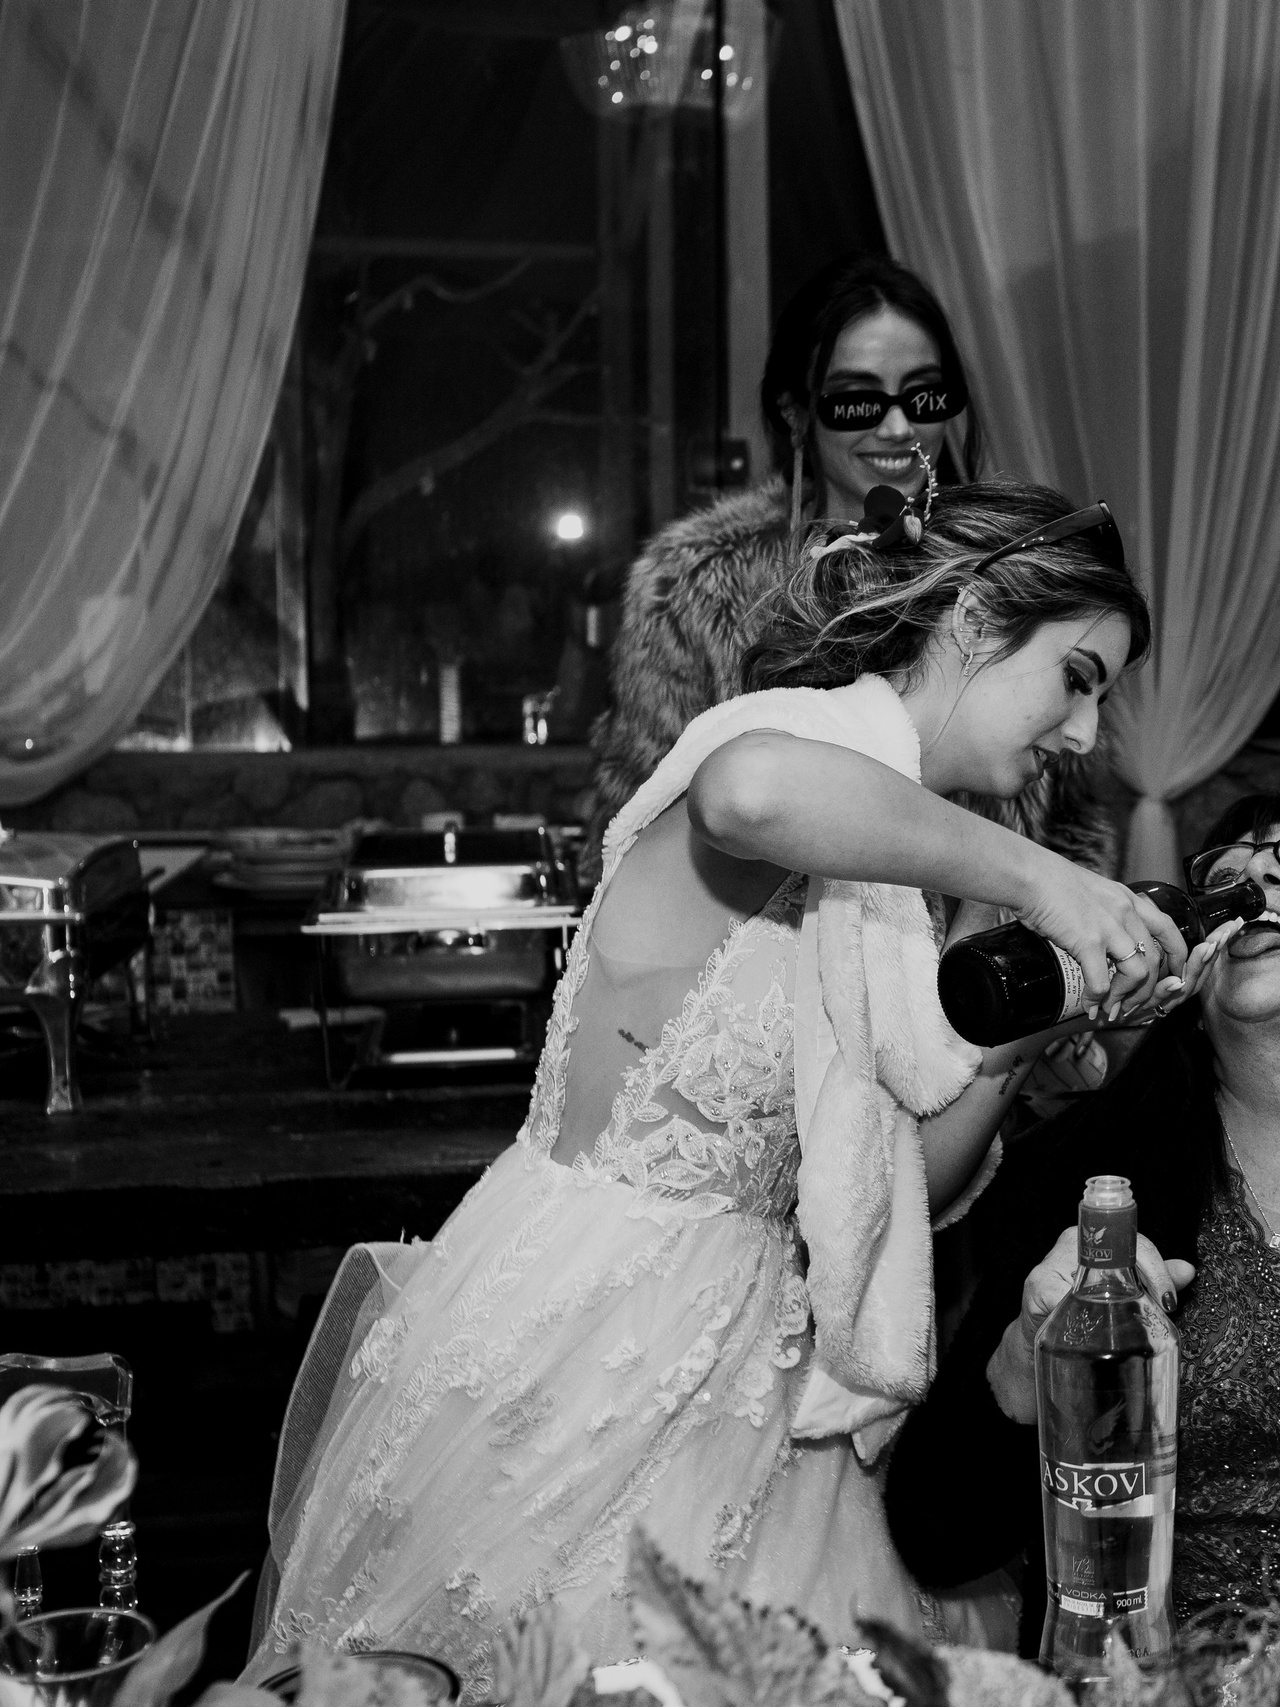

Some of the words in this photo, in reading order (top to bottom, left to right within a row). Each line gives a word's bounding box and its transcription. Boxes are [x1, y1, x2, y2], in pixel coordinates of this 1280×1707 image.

[834, 402, 882, 419] MANDA
[911, 390, 947, 415] Pix
[1081, 1247, 1111, 1259] SKOV
[1043, 1461, 1139, 1496] ASKOV
[1065, 1587, 1107, 1600] VODKA
[1116, 1598, 1132, 1609] 900
